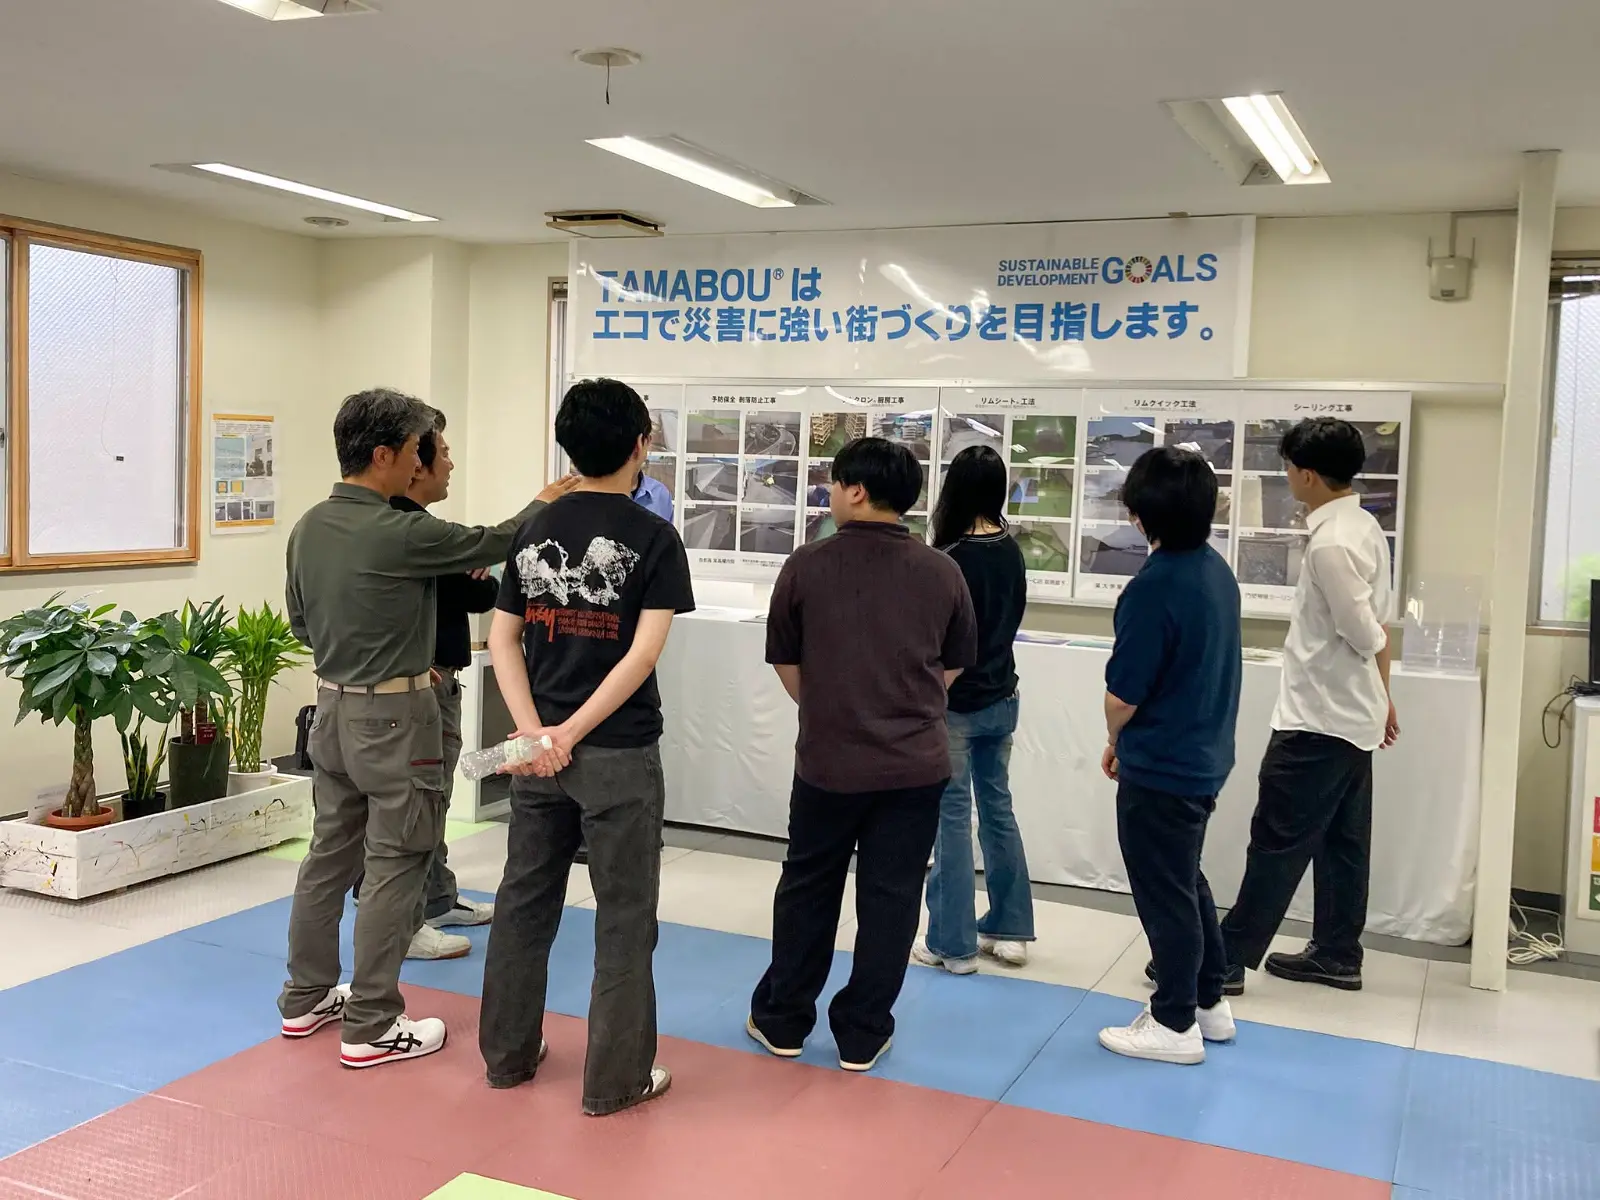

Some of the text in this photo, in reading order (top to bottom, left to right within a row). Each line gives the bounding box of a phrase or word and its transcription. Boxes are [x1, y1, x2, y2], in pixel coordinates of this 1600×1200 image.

[998, 257, 1100, 273] SUSTAINABLE
[1101, 253, 1218, 284] GOALS
[997, 272, 1098, 287] DEVELOPMENT
[592, 300, 1214, 343] エコで災害に強い街づくりを目指します。
